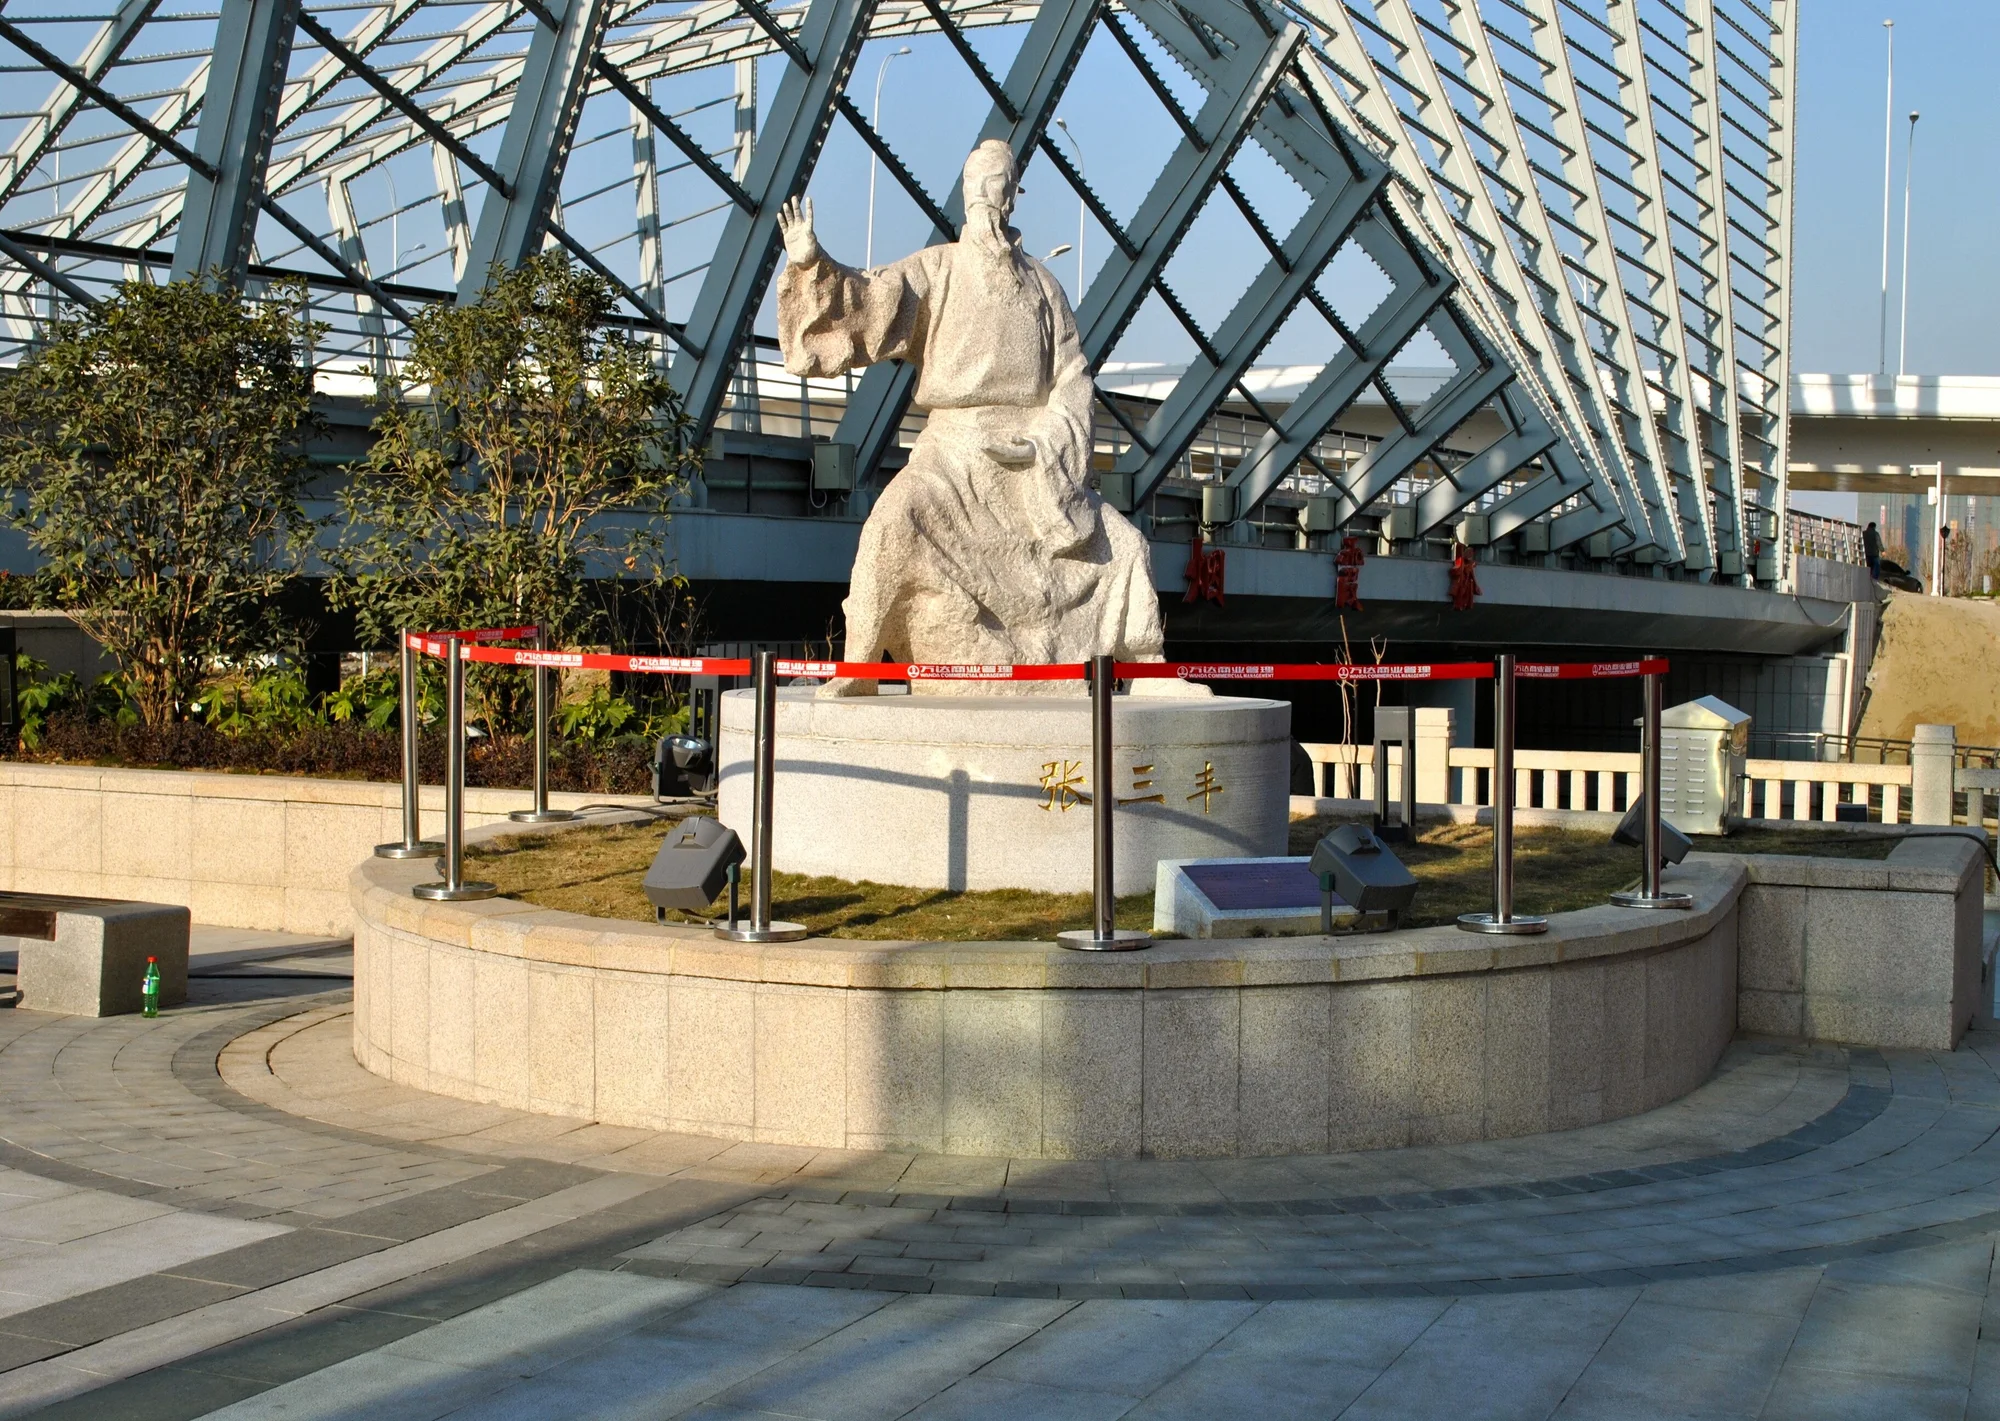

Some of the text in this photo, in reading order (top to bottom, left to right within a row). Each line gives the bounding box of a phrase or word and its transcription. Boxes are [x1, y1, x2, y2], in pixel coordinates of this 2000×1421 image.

[920, 665, 1013, 673] 万达商业管理
[1189, 666, 1274, 674] 万达商业管理
[1038, 760, 1223, 813] 张三丰
